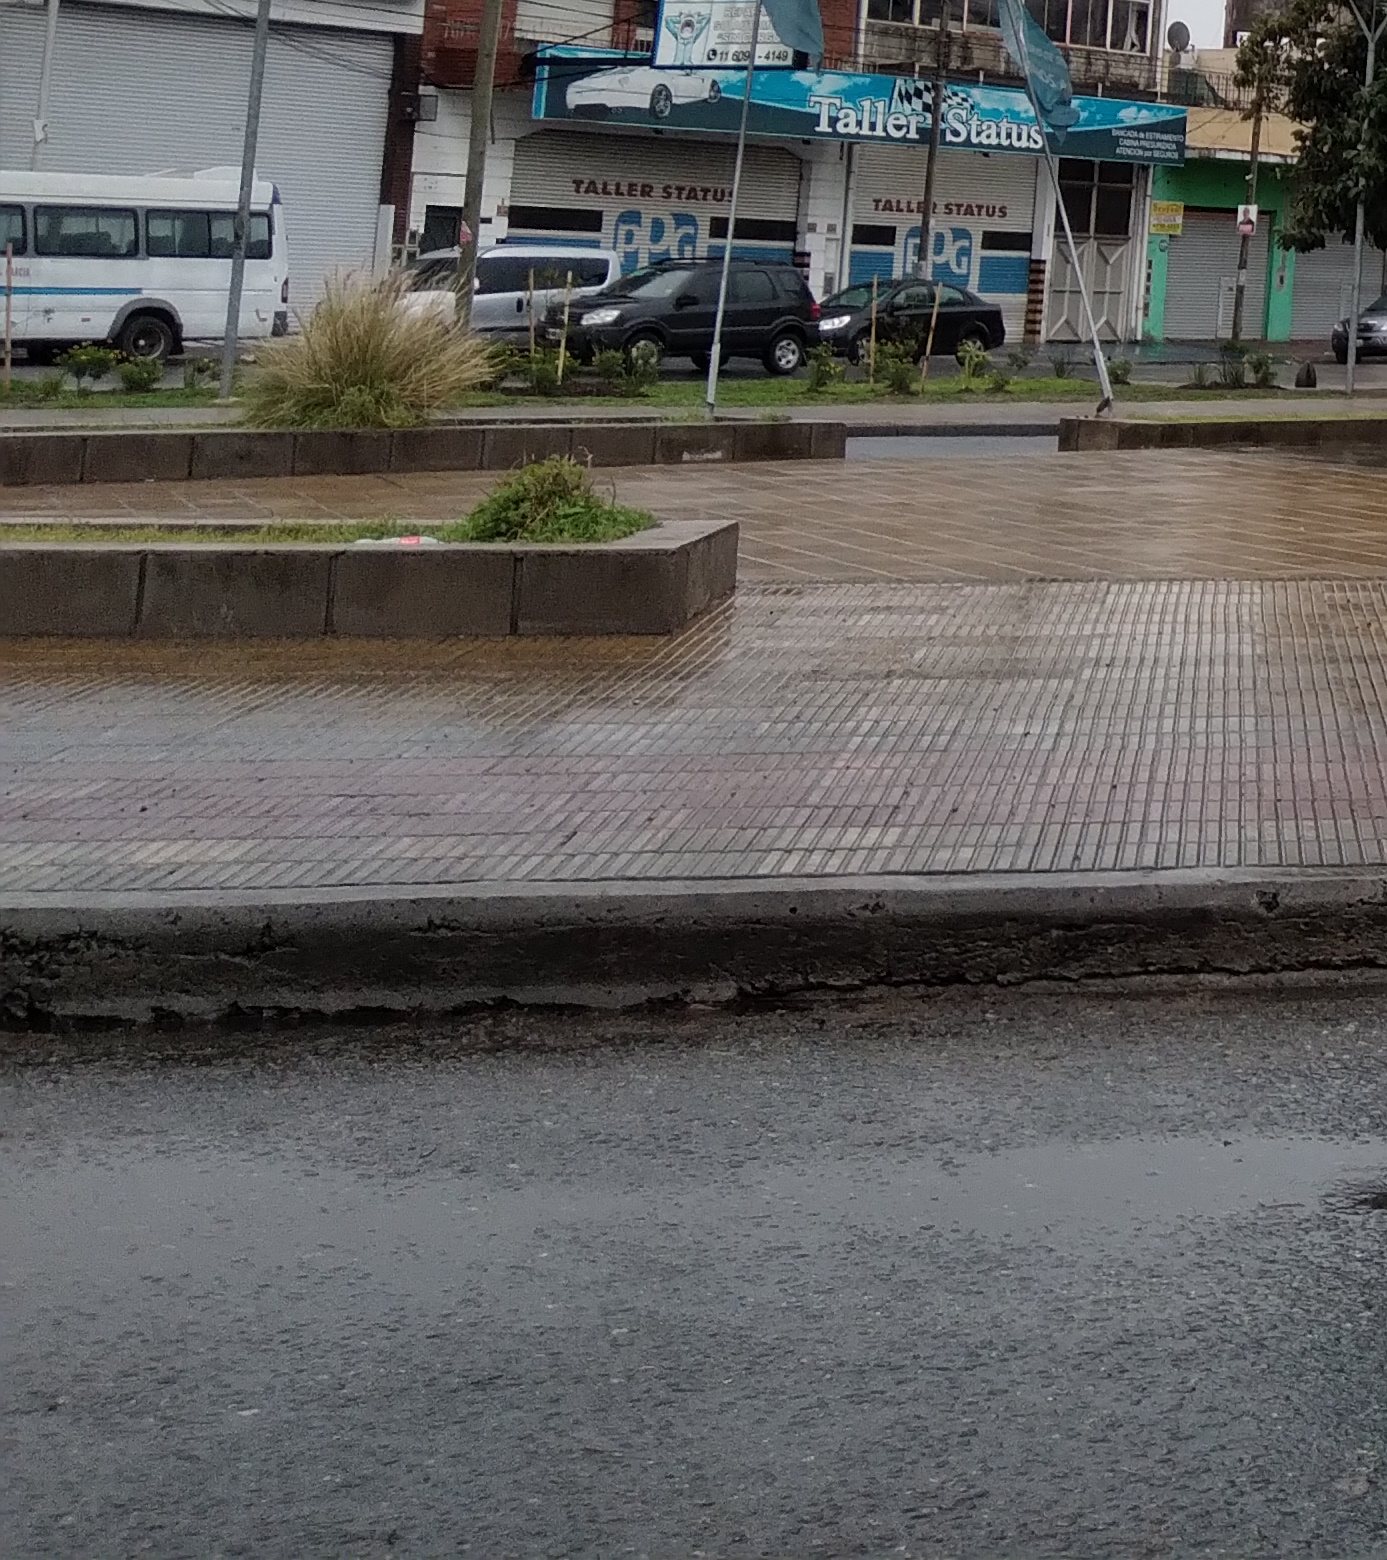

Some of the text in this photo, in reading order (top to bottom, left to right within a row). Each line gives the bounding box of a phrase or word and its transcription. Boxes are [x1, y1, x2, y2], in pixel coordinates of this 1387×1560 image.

[732, 50, 752, 62] 609
[809, 95, 1043, 149] Taller Status
[572, 179, 654, 199] TALLER
[944, 203, 1008, 218] STATUS
